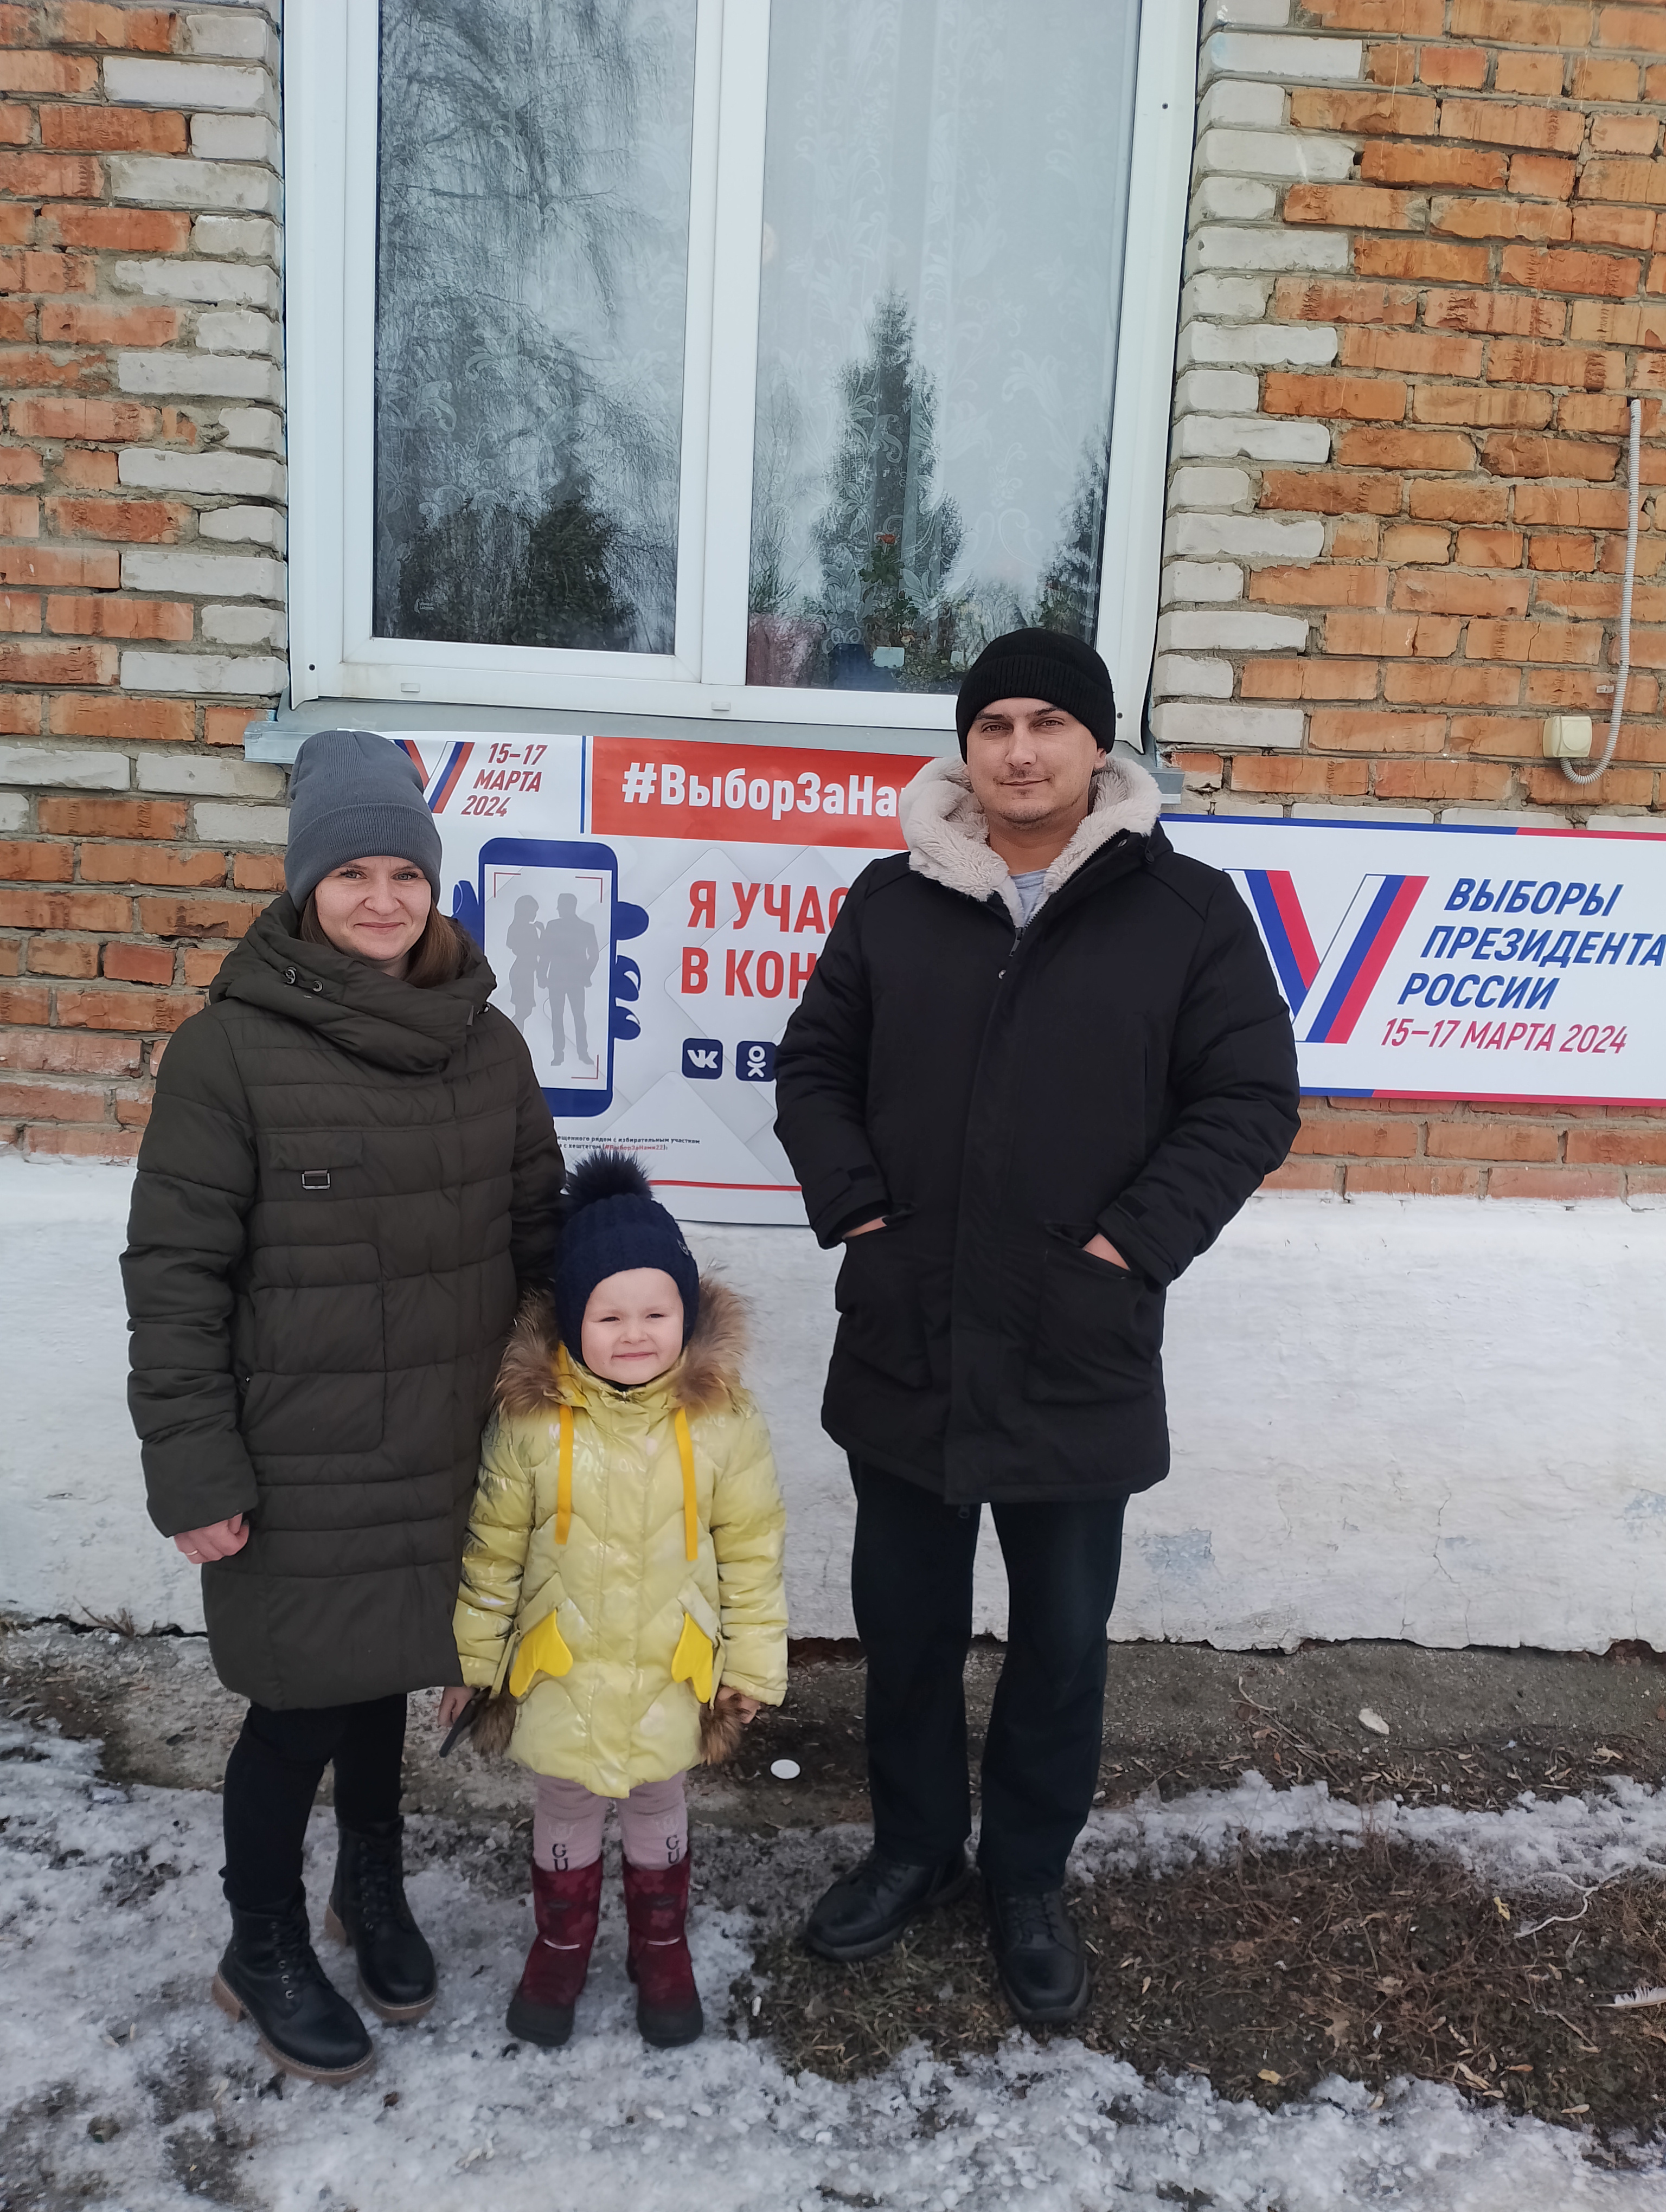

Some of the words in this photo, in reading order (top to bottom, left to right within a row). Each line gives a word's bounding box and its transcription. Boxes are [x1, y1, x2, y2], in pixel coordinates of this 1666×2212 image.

[472, 769, 542, 793] МАРТА
[621, 762, 901, 821] #ВыборЗаНа
[460, 795, 511, 817] 2024
[687, 880, 716, 929] Я
[1444, 878, 1624, 917] ВЫБОРЫ
[1420, 925, 1666, 969] ПРЕЗИДЕНТА
[681, 947, 709, 994] В
[725, 949, 817, 999] КОН
[1397, 973, 1560, 1009] РОССИИ
[1460, 1020, 1556, 1052] МАРТА
[1559, 1024, 1627, 1053] 2024
